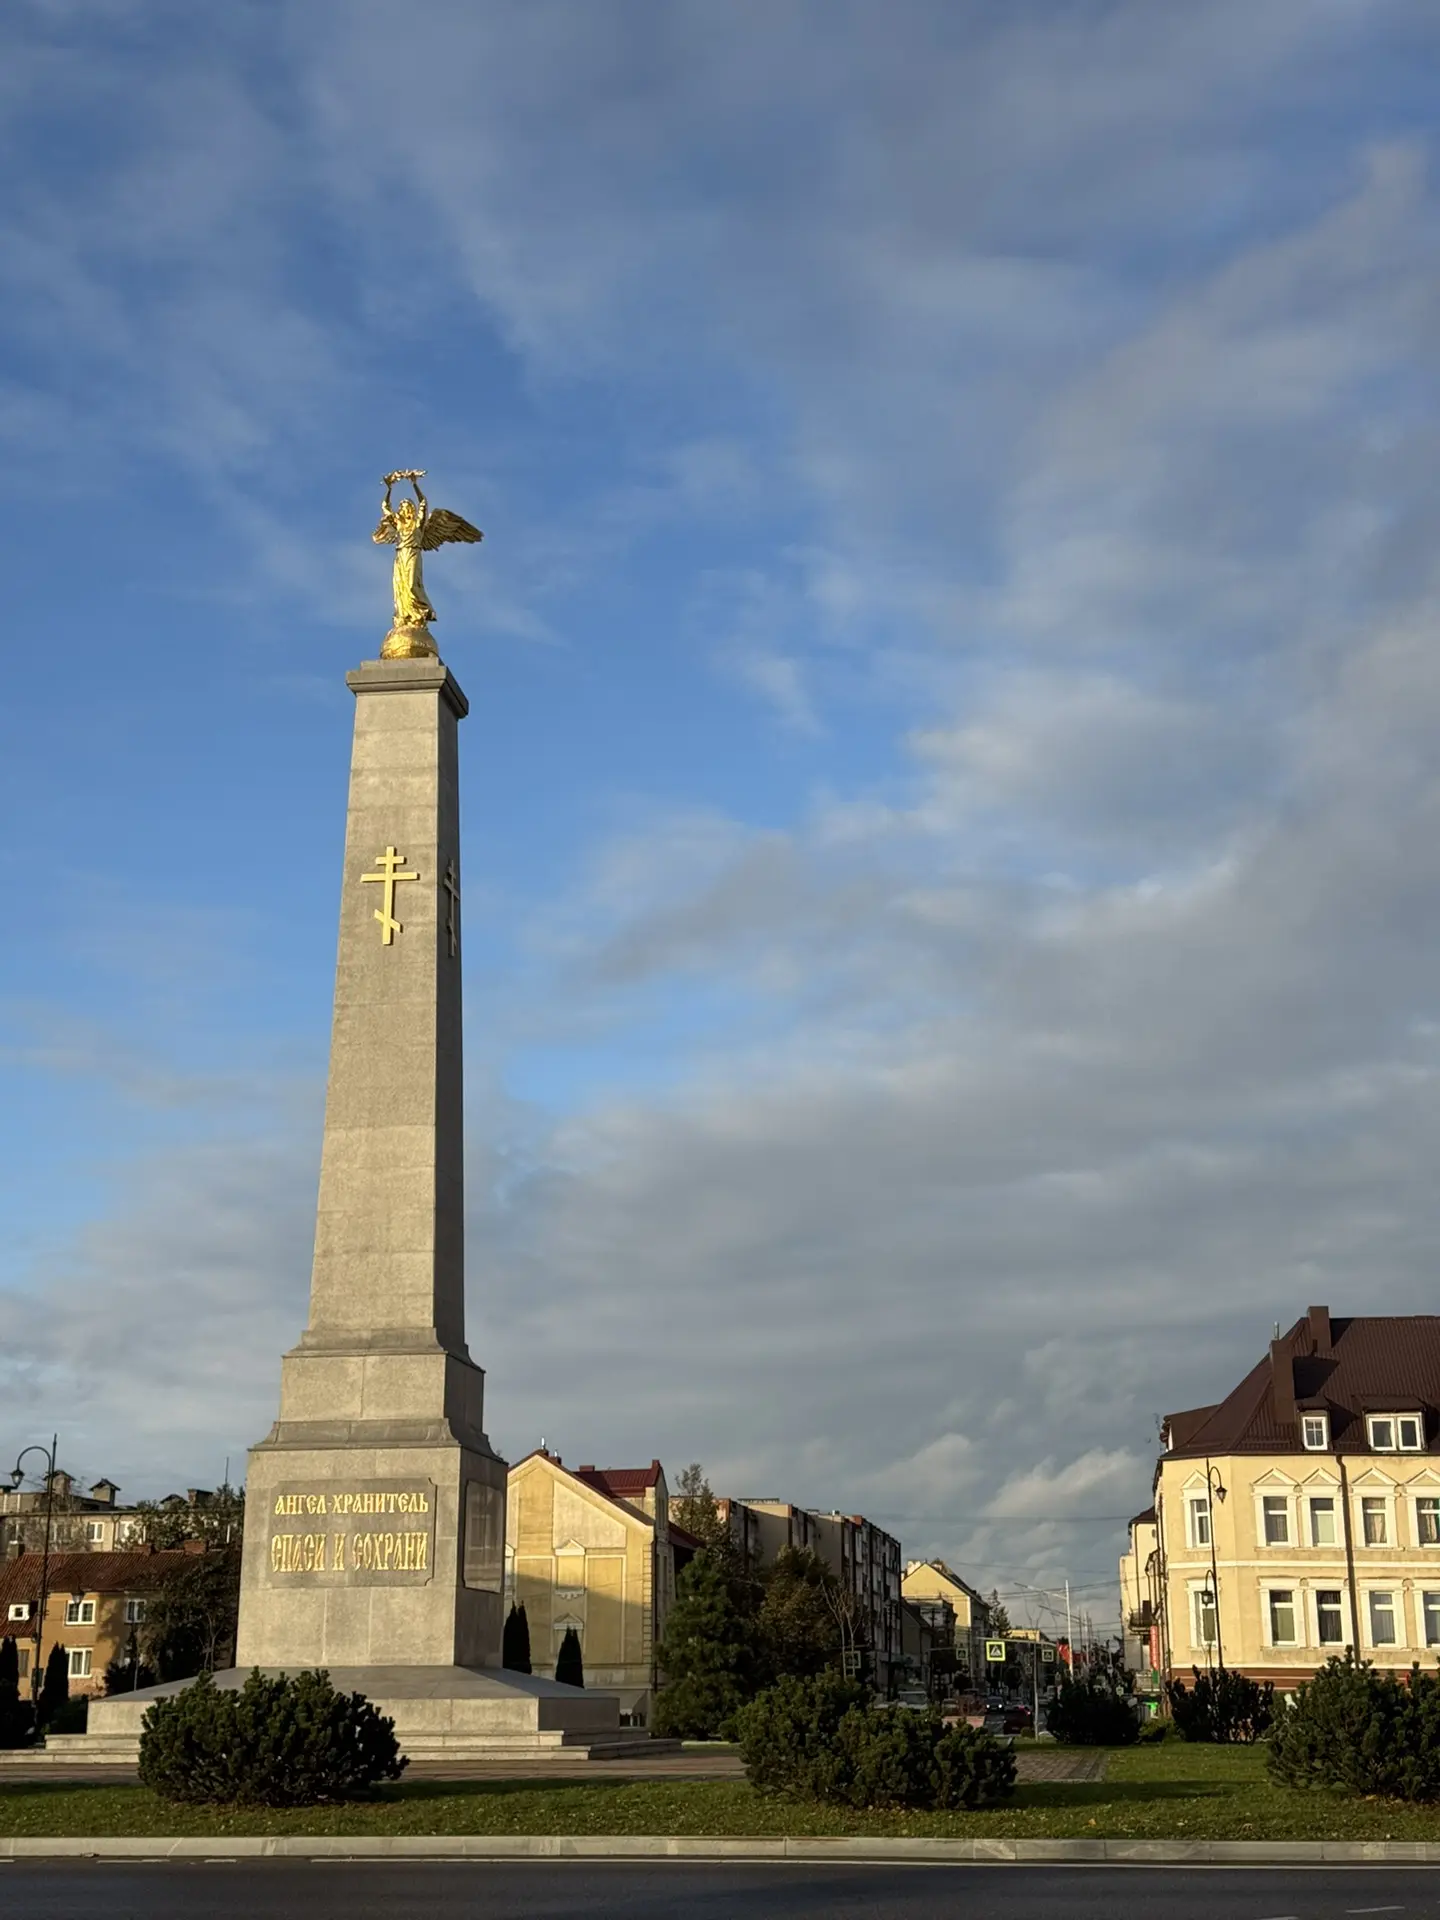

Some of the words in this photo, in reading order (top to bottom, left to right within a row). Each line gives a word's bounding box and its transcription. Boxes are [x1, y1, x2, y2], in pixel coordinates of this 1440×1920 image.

[271, 1534, 326, 1573] СПАСИ
[333, 1533, 346, 1571] И
[353, 1532, 428, 1571] СОХРАНИ
